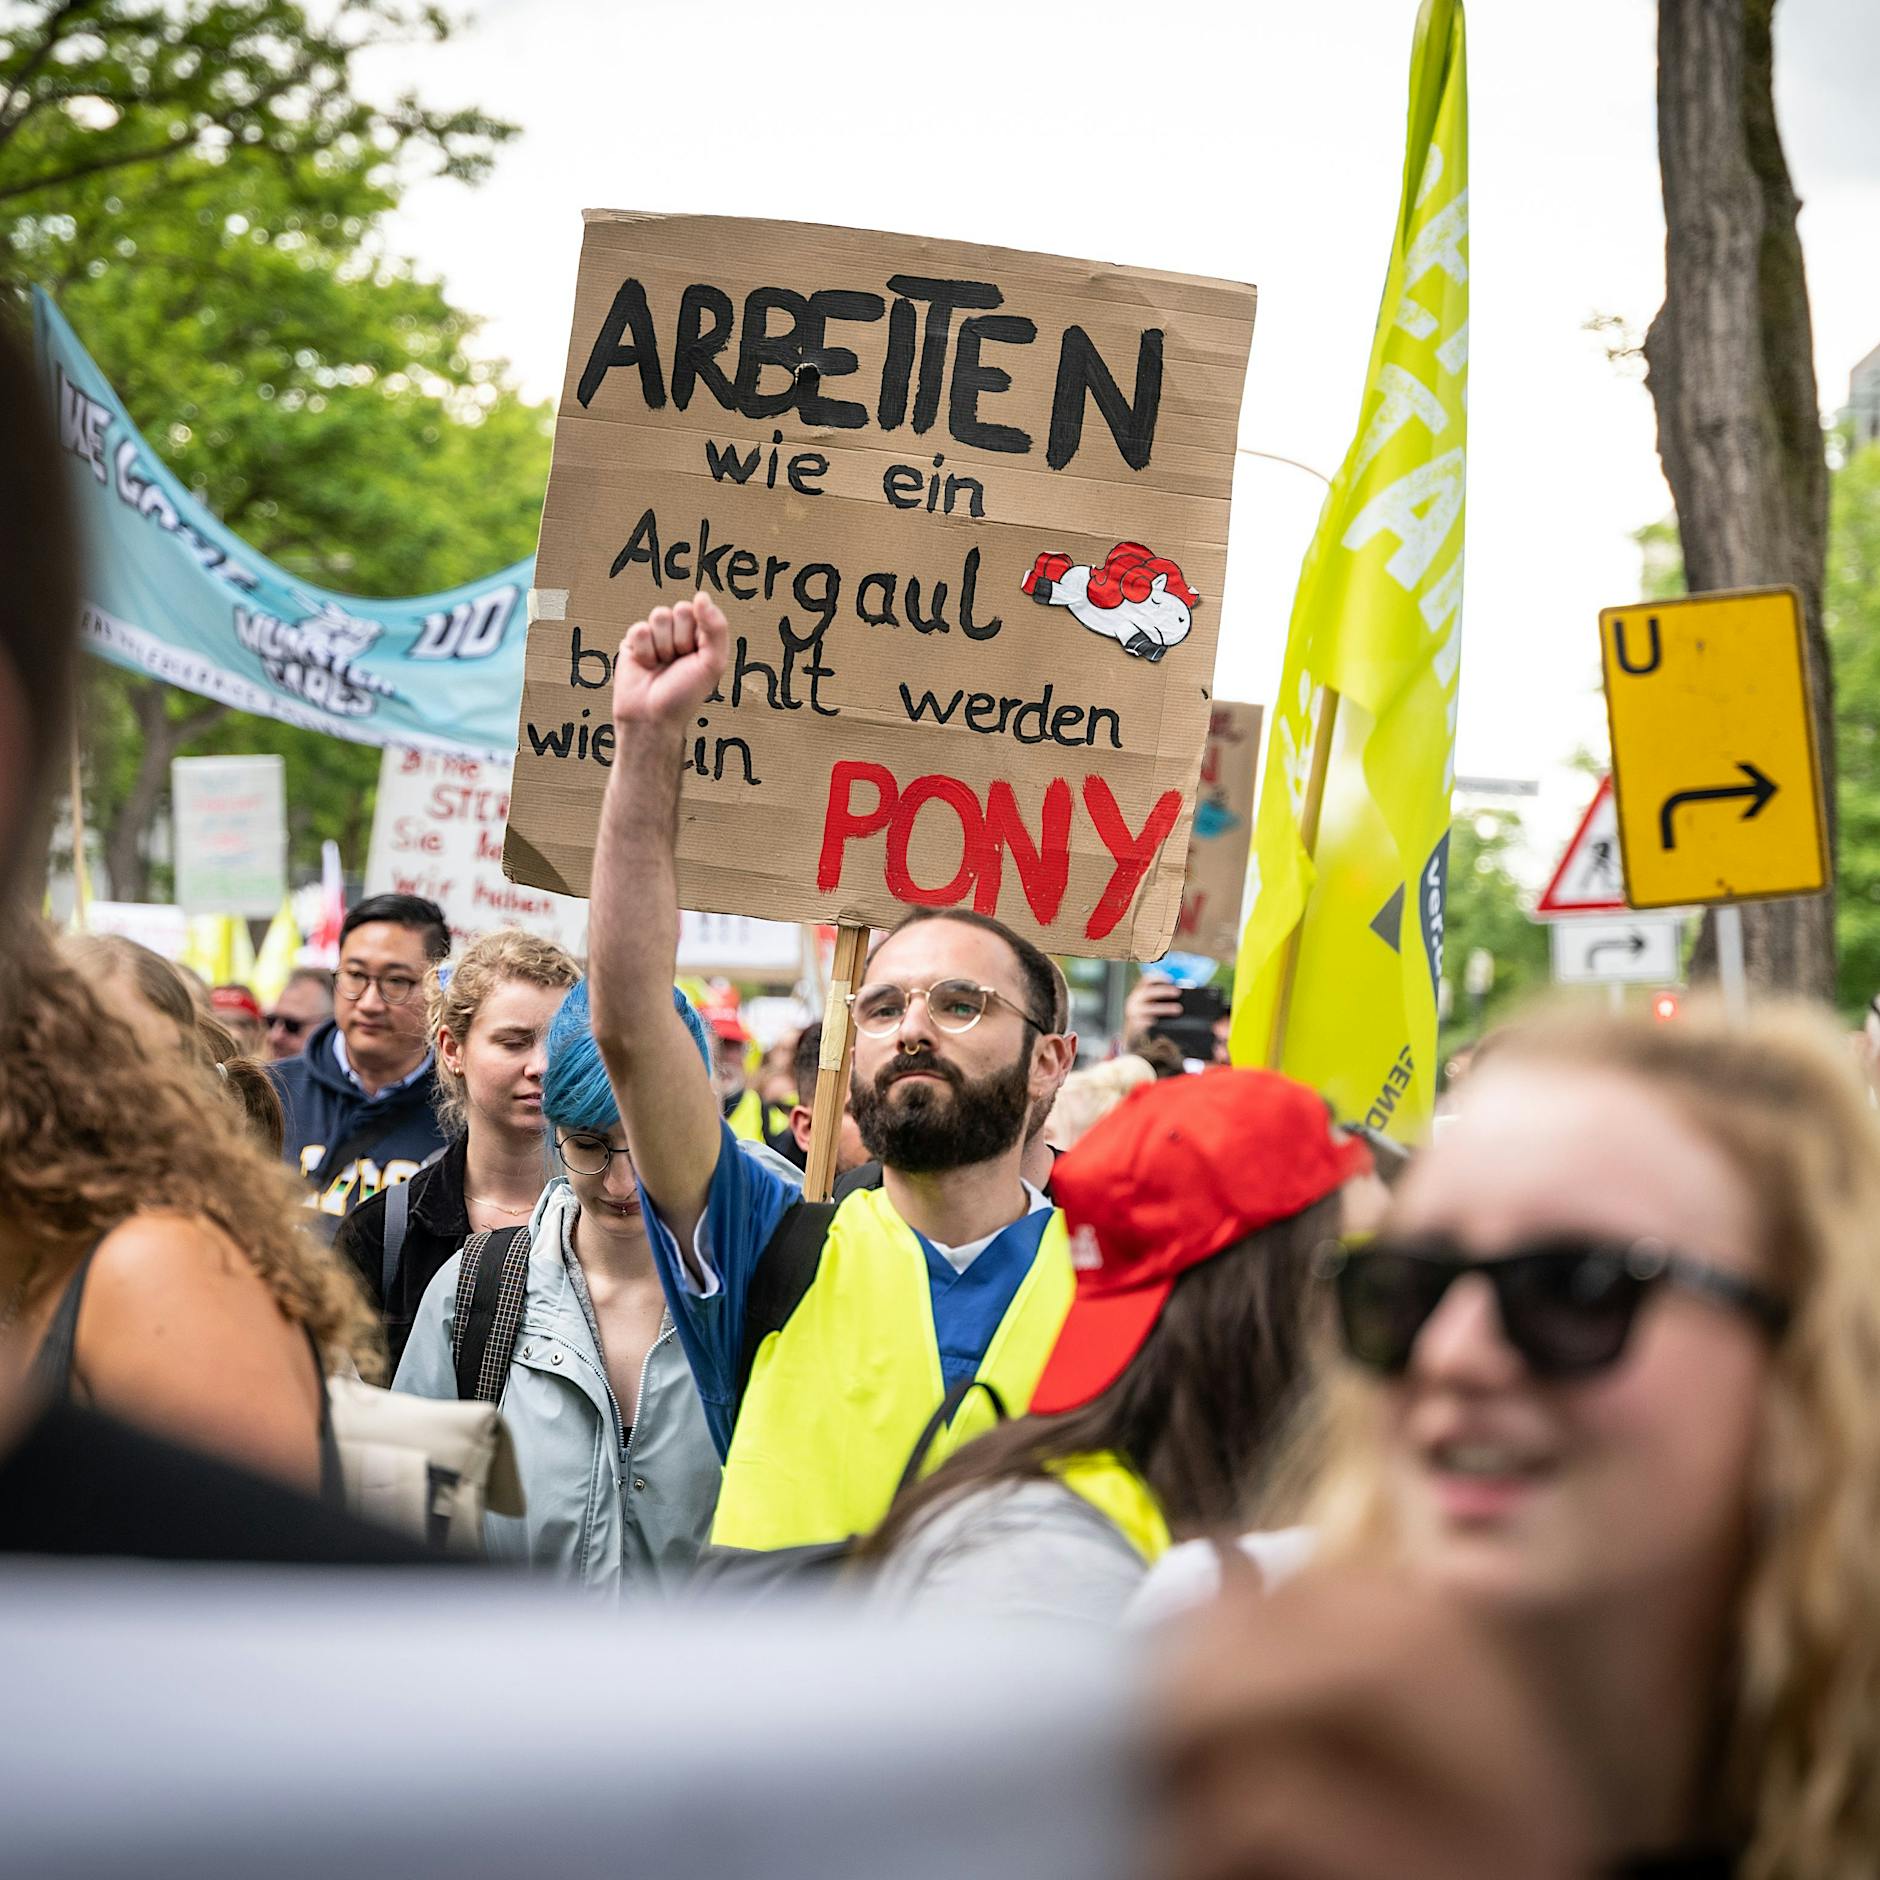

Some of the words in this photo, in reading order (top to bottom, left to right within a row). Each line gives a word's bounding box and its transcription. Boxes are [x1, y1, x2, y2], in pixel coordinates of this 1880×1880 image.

[576, 274, 1165, 472] ARBEITEN
[706, 430, 830, 495] wie
[883, 454, 985, 517] ein
[609, 508, 1002, 652] Ackergaul
[570, 626, 840, 717] bhlt
[898, 681, 1123, 749] werden
[1614, 617, 1661, 676] U
[683, 717, 762, 786] in
[816, 760, 1182, 941] PONY
